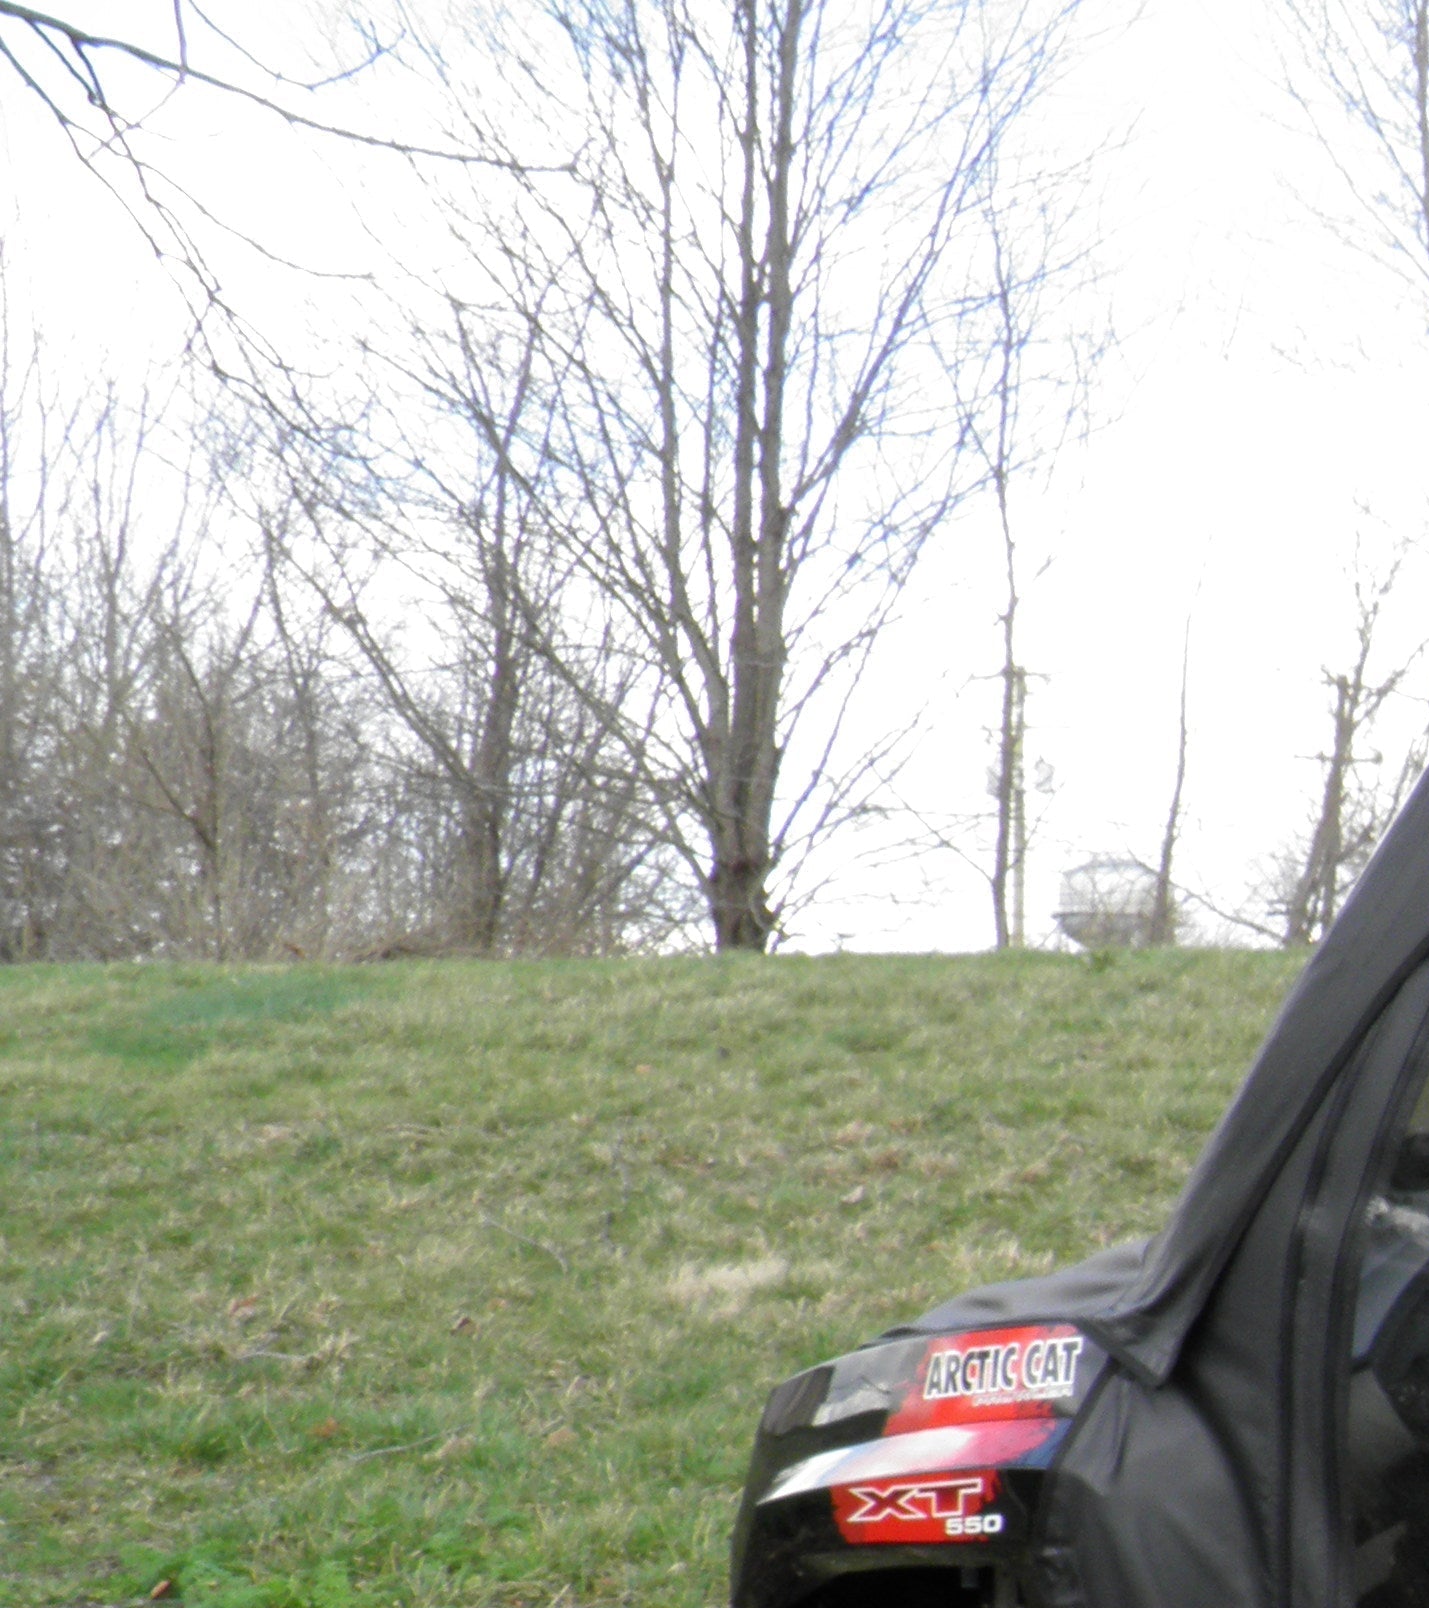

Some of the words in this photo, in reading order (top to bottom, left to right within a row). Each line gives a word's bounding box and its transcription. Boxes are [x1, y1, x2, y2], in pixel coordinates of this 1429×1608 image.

[923, 1342, 1020, 1400] ARCTIC
[1022, 1335, 1083, 1388] CAT
[847, 1478, 982, 1522] XT
[945, 1514, 1003, 1535] 550
